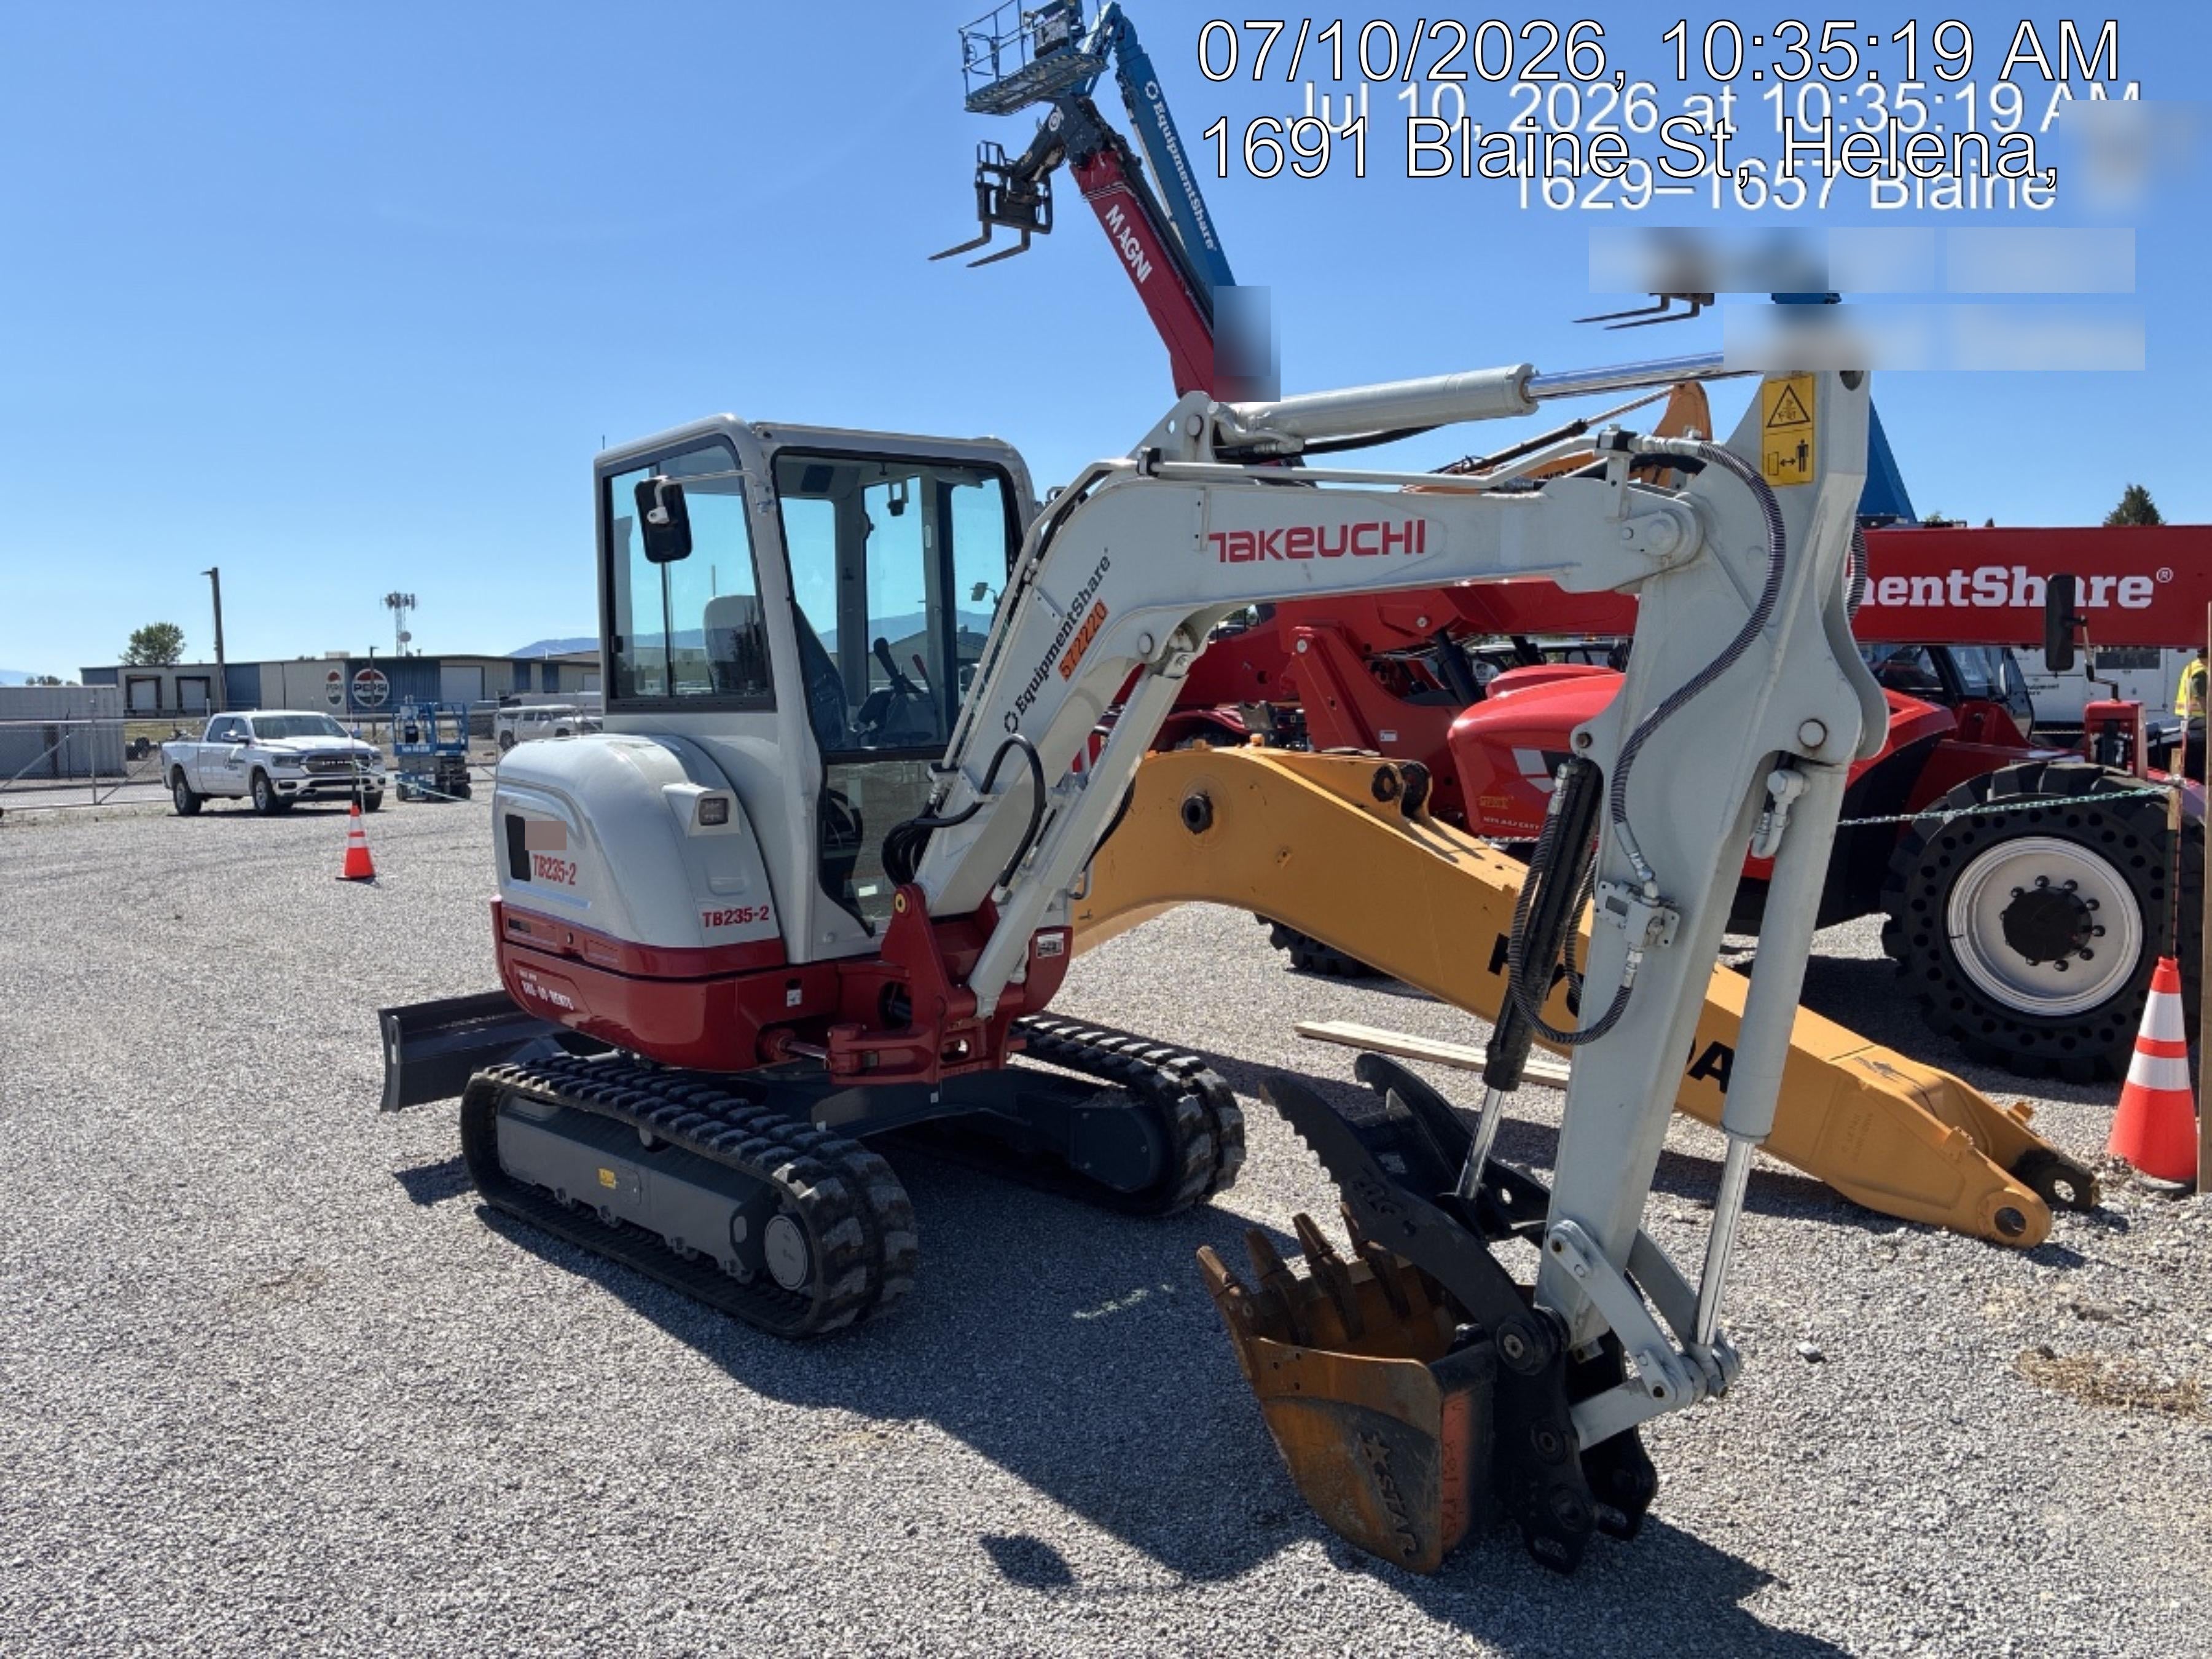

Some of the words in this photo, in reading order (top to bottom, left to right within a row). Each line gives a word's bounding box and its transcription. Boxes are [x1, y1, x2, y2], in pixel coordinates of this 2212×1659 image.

[1105, 204, 1153, 284] MAGNI
[1059, 602, 1107, 677] 572220
[533, 854, 576, 885] TB235-2
[702, 905, 769, 928] TB235-2
